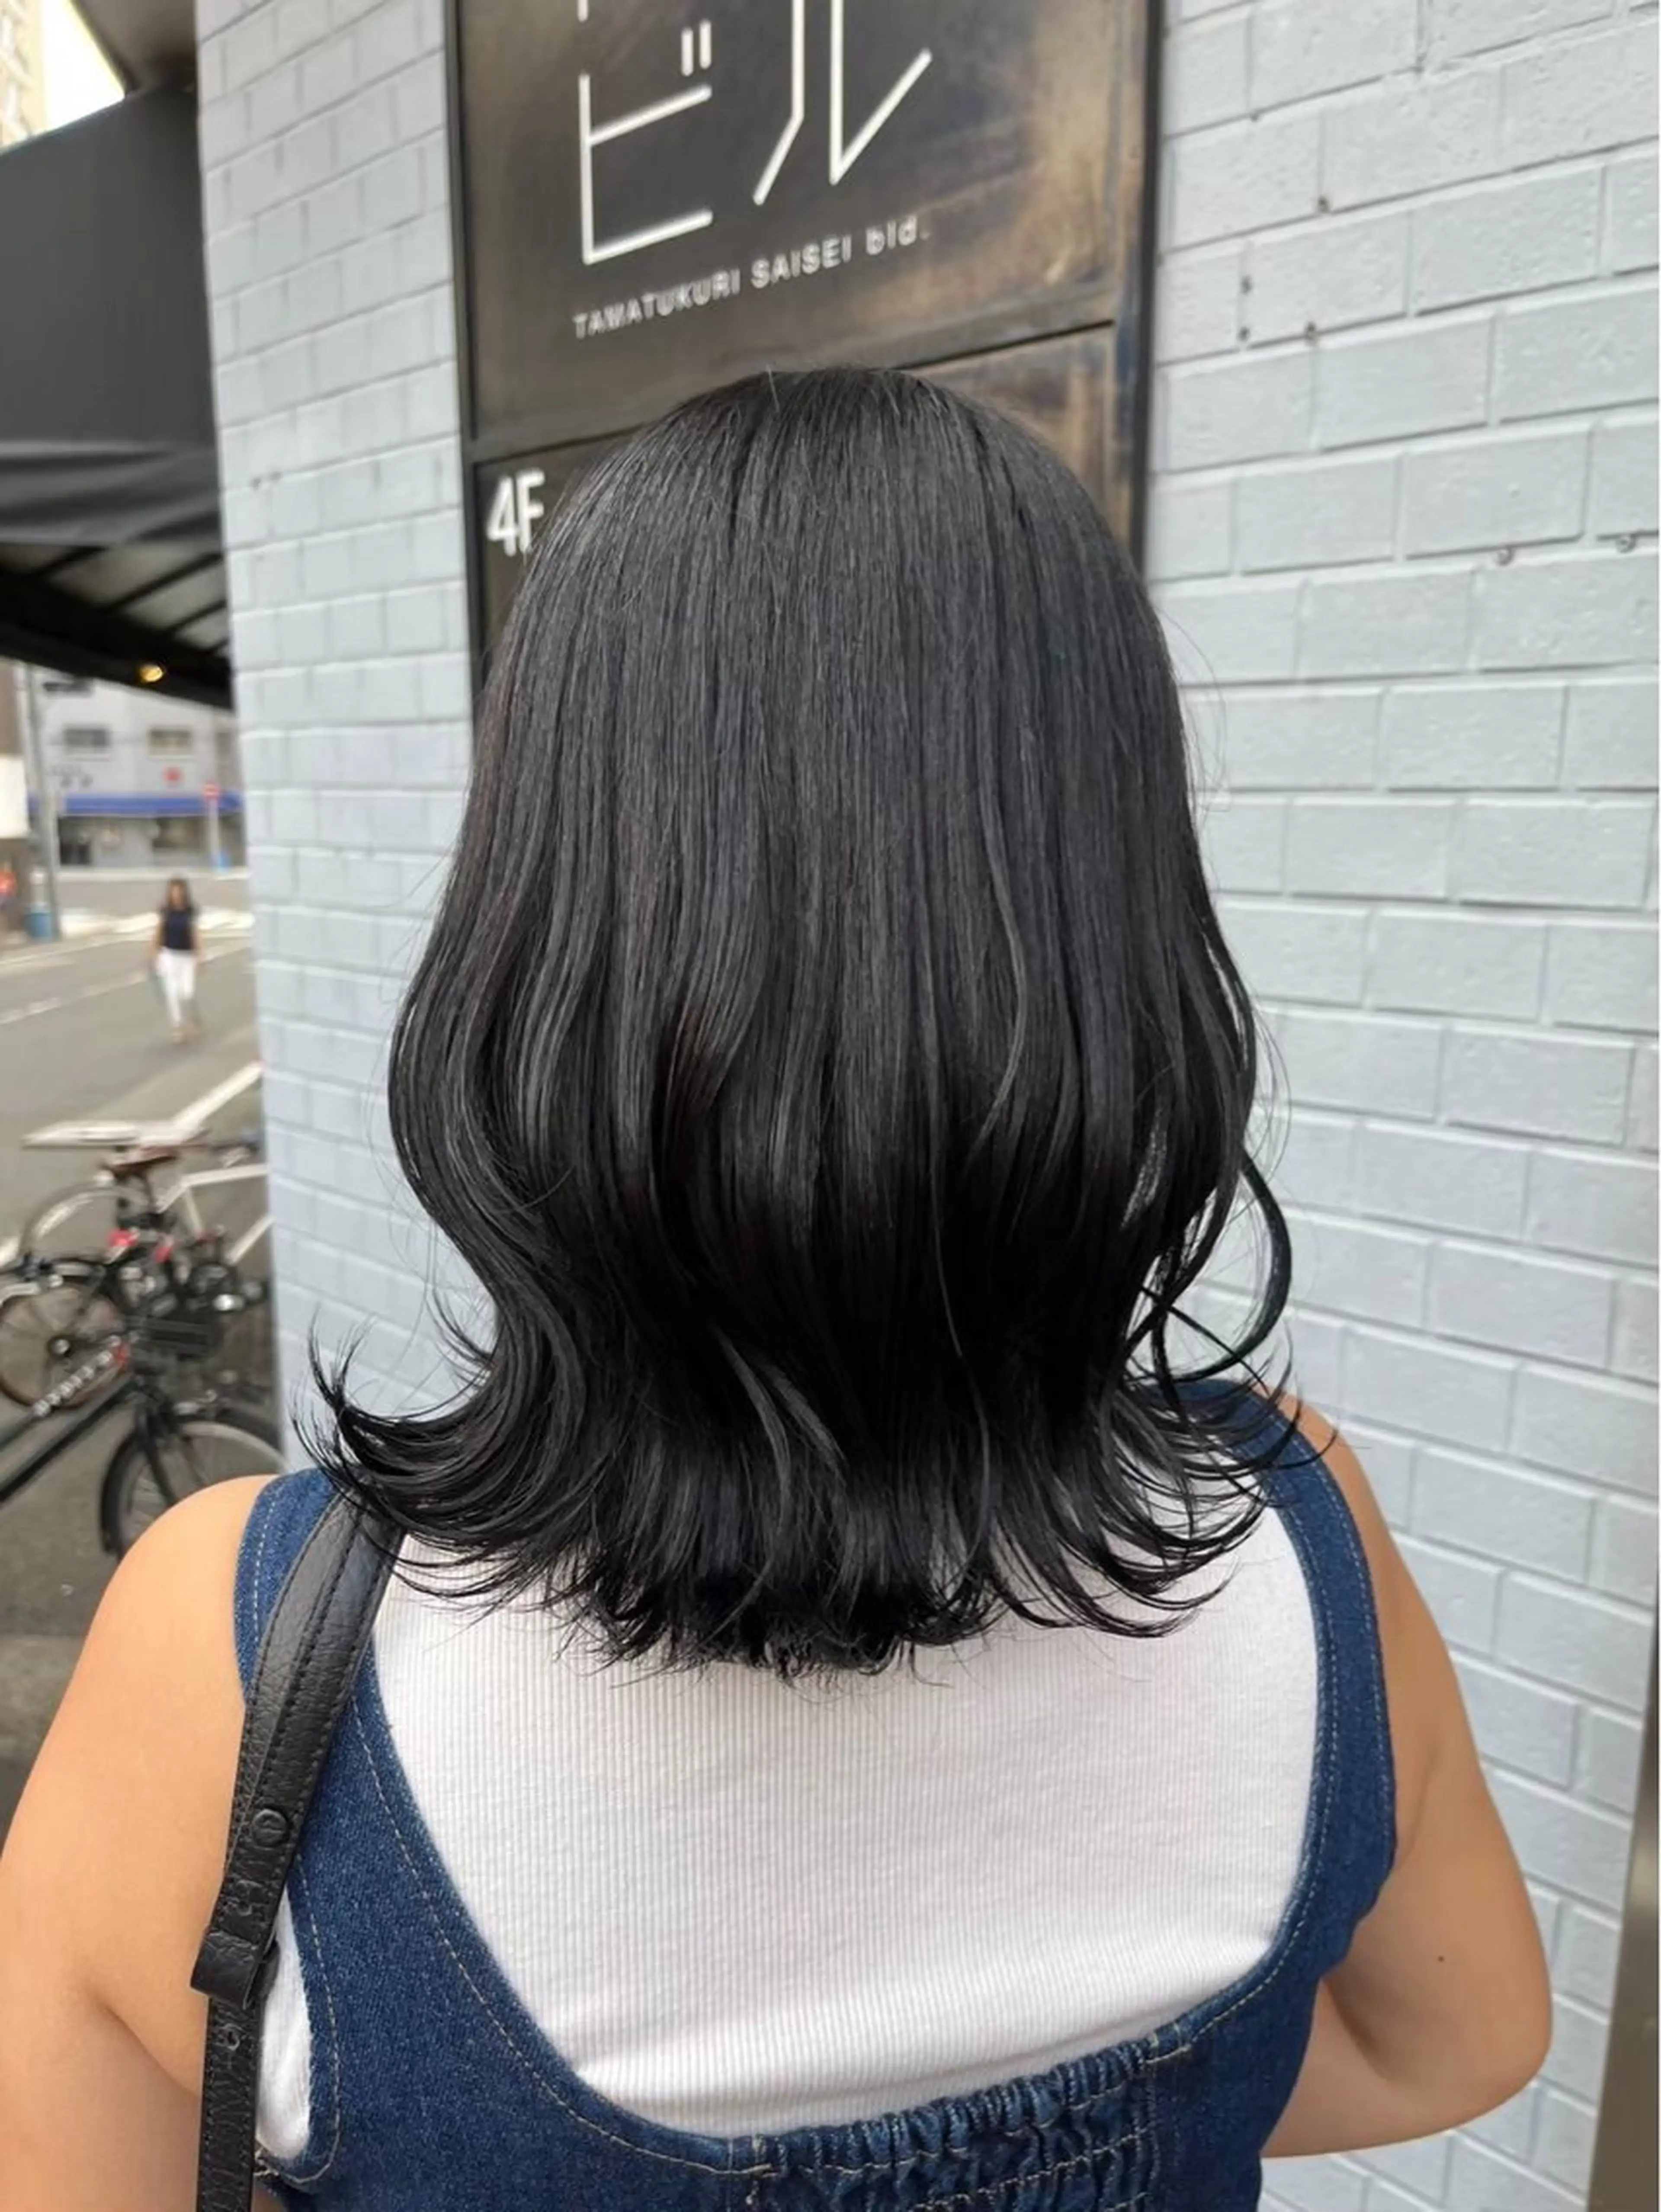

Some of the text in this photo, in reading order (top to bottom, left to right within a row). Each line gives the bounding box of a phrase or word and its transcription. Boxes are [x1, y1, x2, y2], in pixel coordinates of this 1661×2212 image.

[578, 0, 933, 266] ビル
[750, 234, 852, 289] SAISEI
[487, 468, 545, 558] 4F
